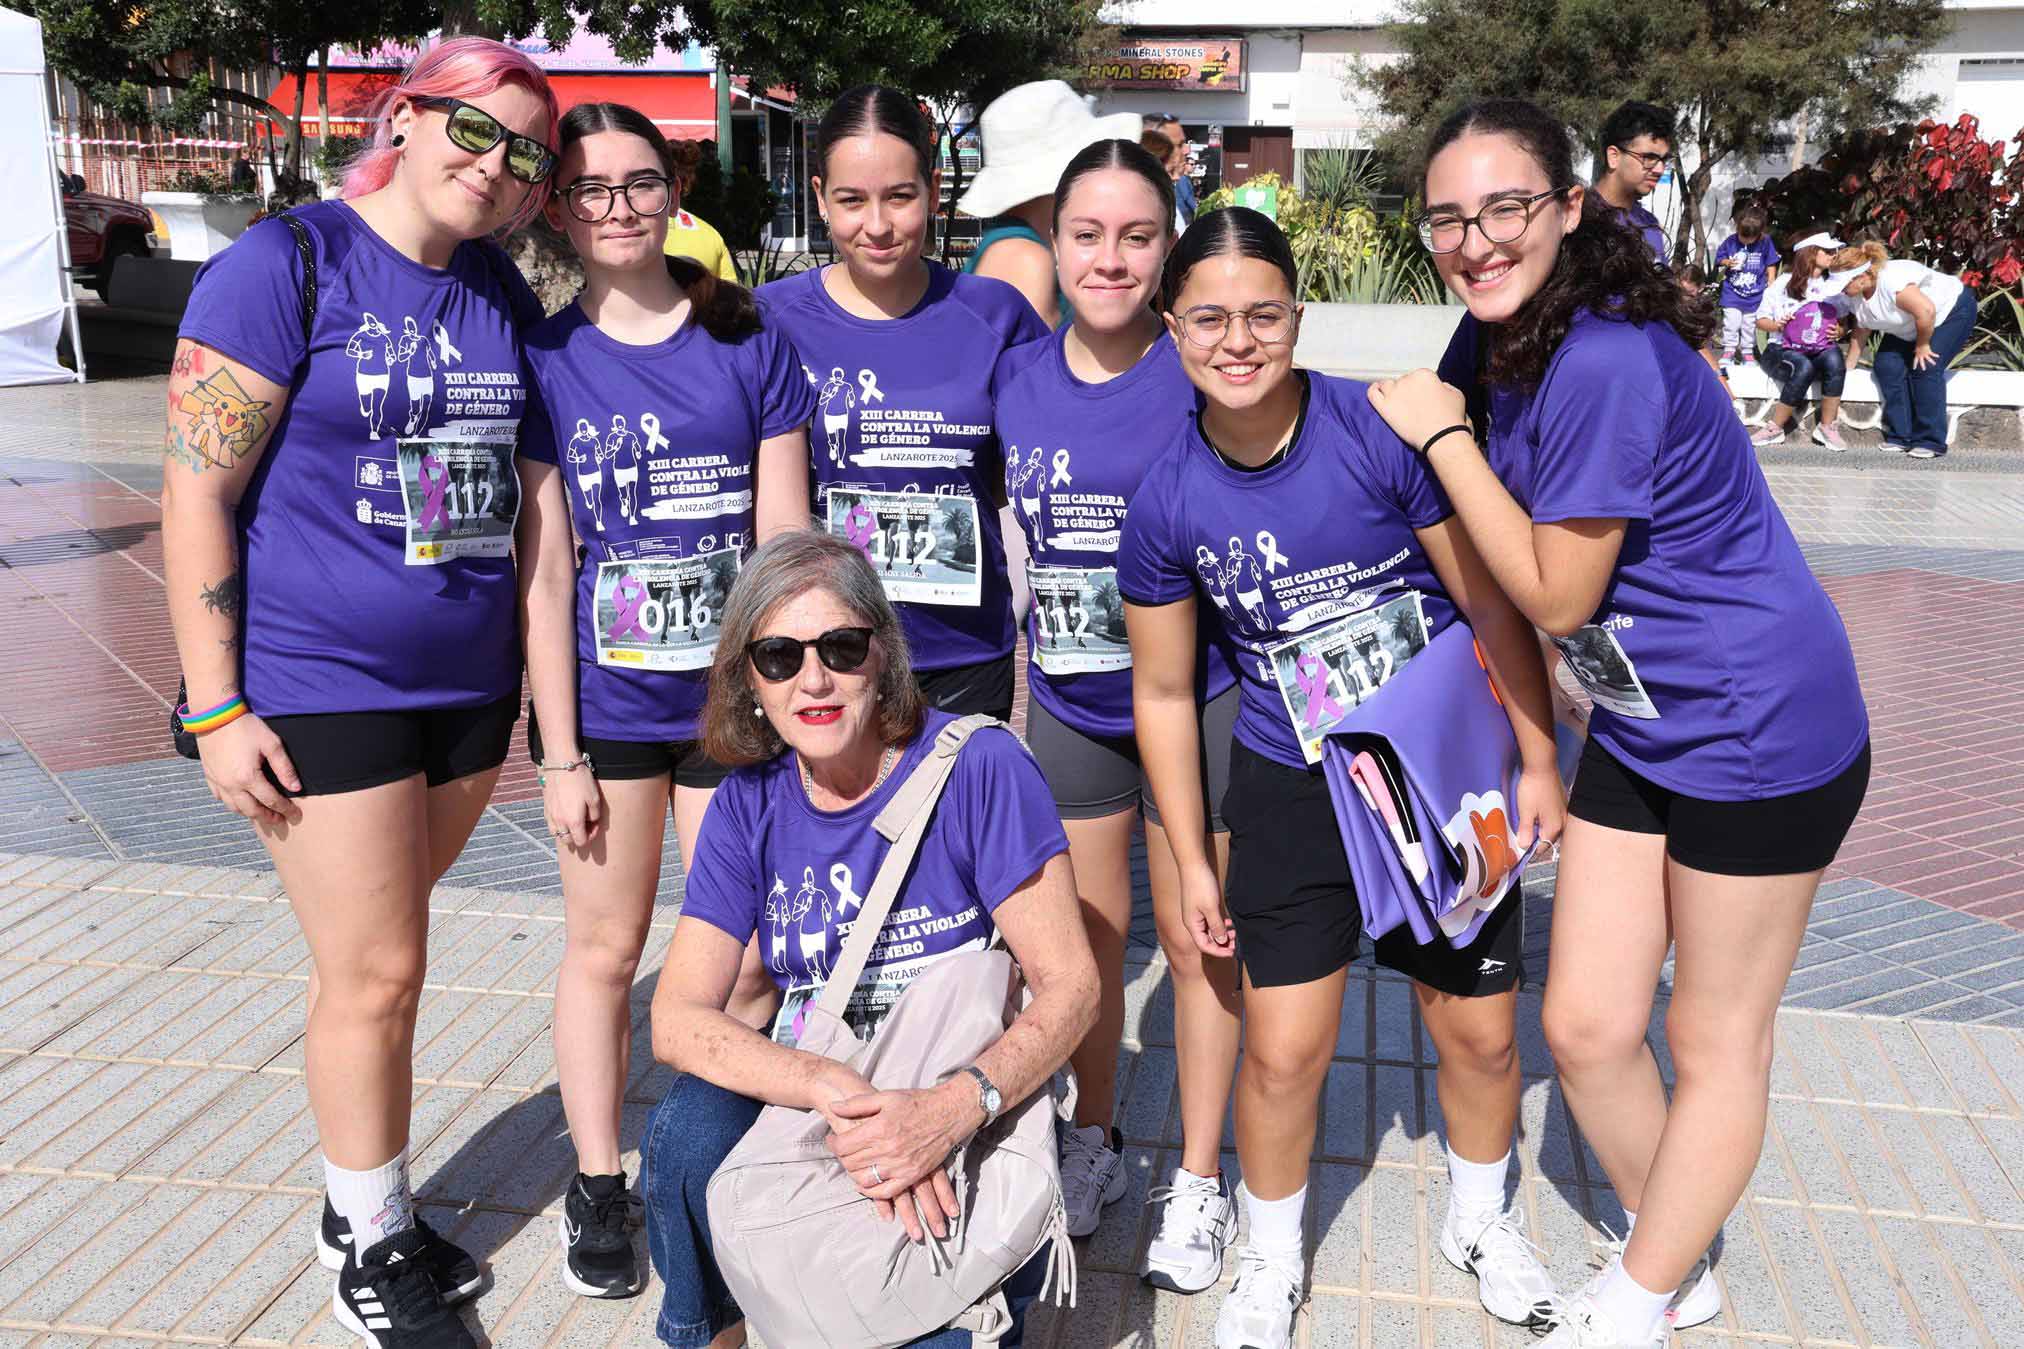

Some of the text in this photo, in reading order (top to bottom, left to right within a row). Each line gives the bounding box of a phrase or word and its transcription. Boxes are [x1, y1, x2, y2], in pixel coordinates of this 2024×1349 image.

[1120, 48, 1161, 57] MINERAL
[1165, 48, 1203, 57] STONES
[1139, 63, 1190, 80] SHOP
[303, 123, 361, 134] SASUNG
[443, 373, 519, 385] XIII CARRERA
[446, 388, 496, 400] CONTRA
[497, 388, 512, 400] LA
[445, 400, 510, 416] DE GÉNERO
[860, 410, 944, 421] XIII CARRERA
[460, 426, 508, 436] LANZAROTE
[860, 423, 991, 435] CONTRA LA VIOLENCIA
[860, 432, 931, 445] DE GÉNERO
[647, 454, 730, 471] XIII CARRERA
[880, 453, 937, 461] LANZAROTE
[649, 461, 751, 483] CONTRA LA VIOLE
[650, 480, 719, 497] DE GÉNERO
[445, 481, 493, 519] 112
[672, 500, 725, 513] LANZAROTE
[1049, 494, 1126, 506] XIII CARRERA
[1051, 506, 1097, 517] CONTRA
[1097, 507, 1114, 517] LA
[1053, 516, 1115, 529] DE GÉNERO
[870, 531, 937, 565] 112
[1269, 561, 1358, 591] XIII CARRERA
[1275, 547, 1411, 600] CONTRA LA VIOLENCIA
[1280, 586, 1350, 612] DE GÉNERO
[638, 593, 712, 633] 016
[1035, 606, 1095, 638] 112
[1326, 650, 1393, 706] 112
[898, 925, 921, 940] LA
[920, 905, 978, 935] VIOLEN
[868, 966, 928, 981] LANZARO
